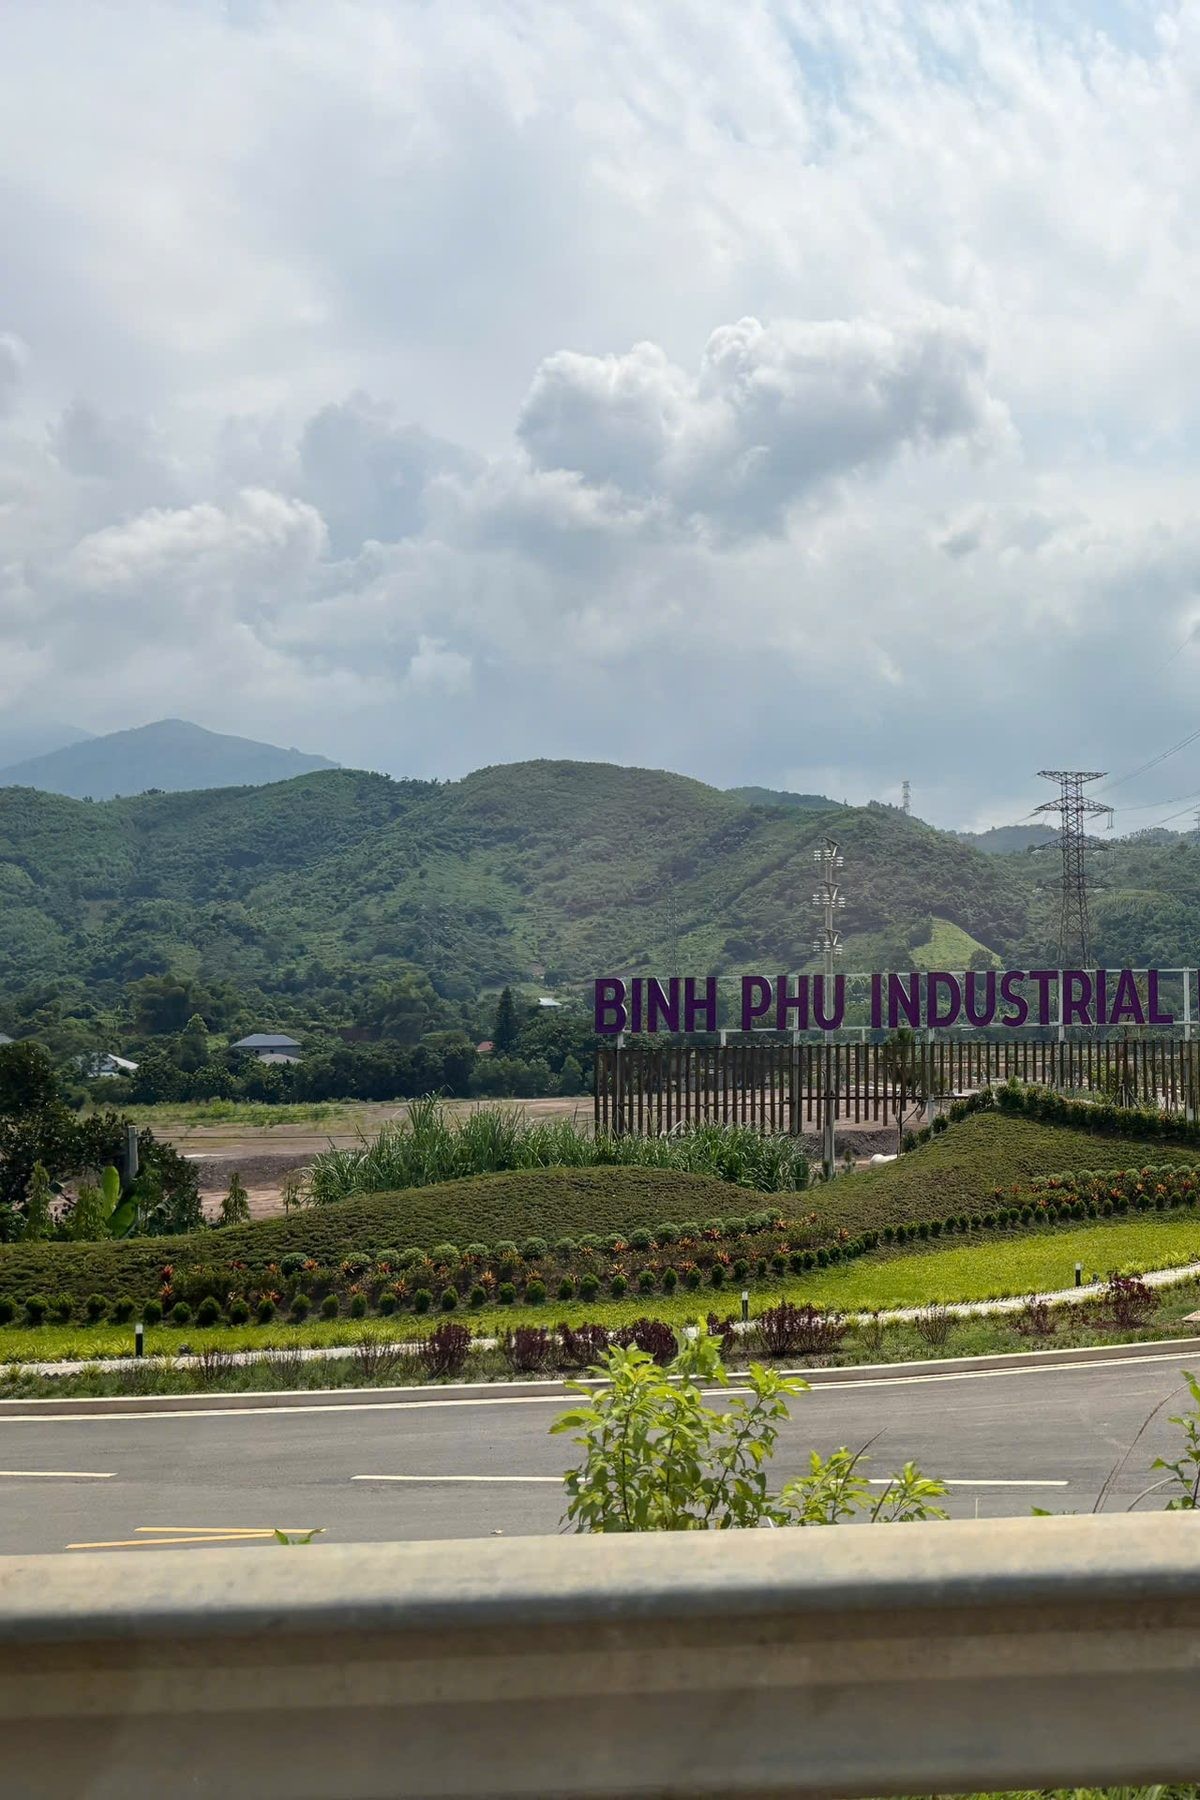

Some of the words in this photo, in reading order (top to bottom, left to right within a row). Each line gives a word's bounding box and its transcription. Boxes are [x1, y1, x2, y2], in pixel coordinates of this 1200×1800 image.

[594, 976, 716, 1033] BINH
[741, 974, 845, 1030] PHU
[871, 969, 1174, 1028] INDUSTRIAL
